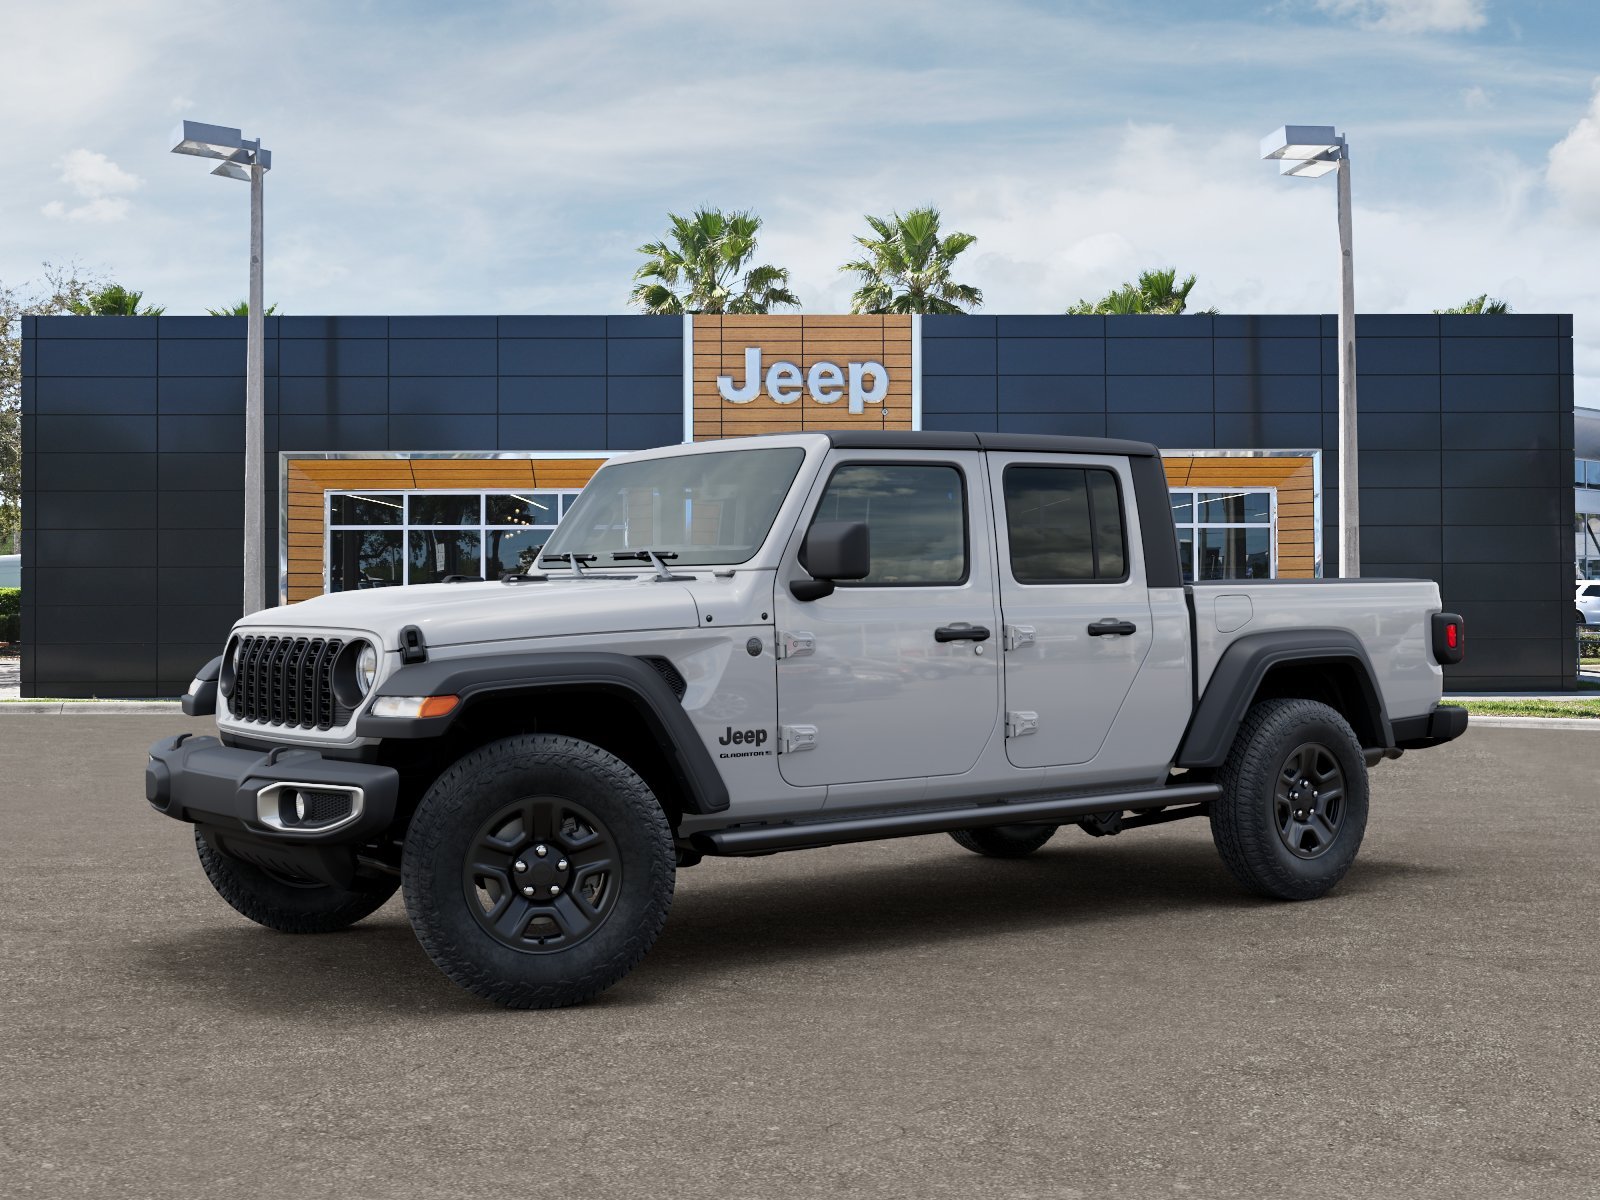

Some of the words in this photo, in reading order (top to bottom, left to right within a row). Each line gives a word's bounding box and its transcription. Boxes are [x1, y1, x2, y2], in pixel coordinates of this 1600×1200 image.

[716, 346, 890, 415] Jeep
[718, 726, 768, 747] Jeep
[719, 751, 764, 759] GLADIATOR
